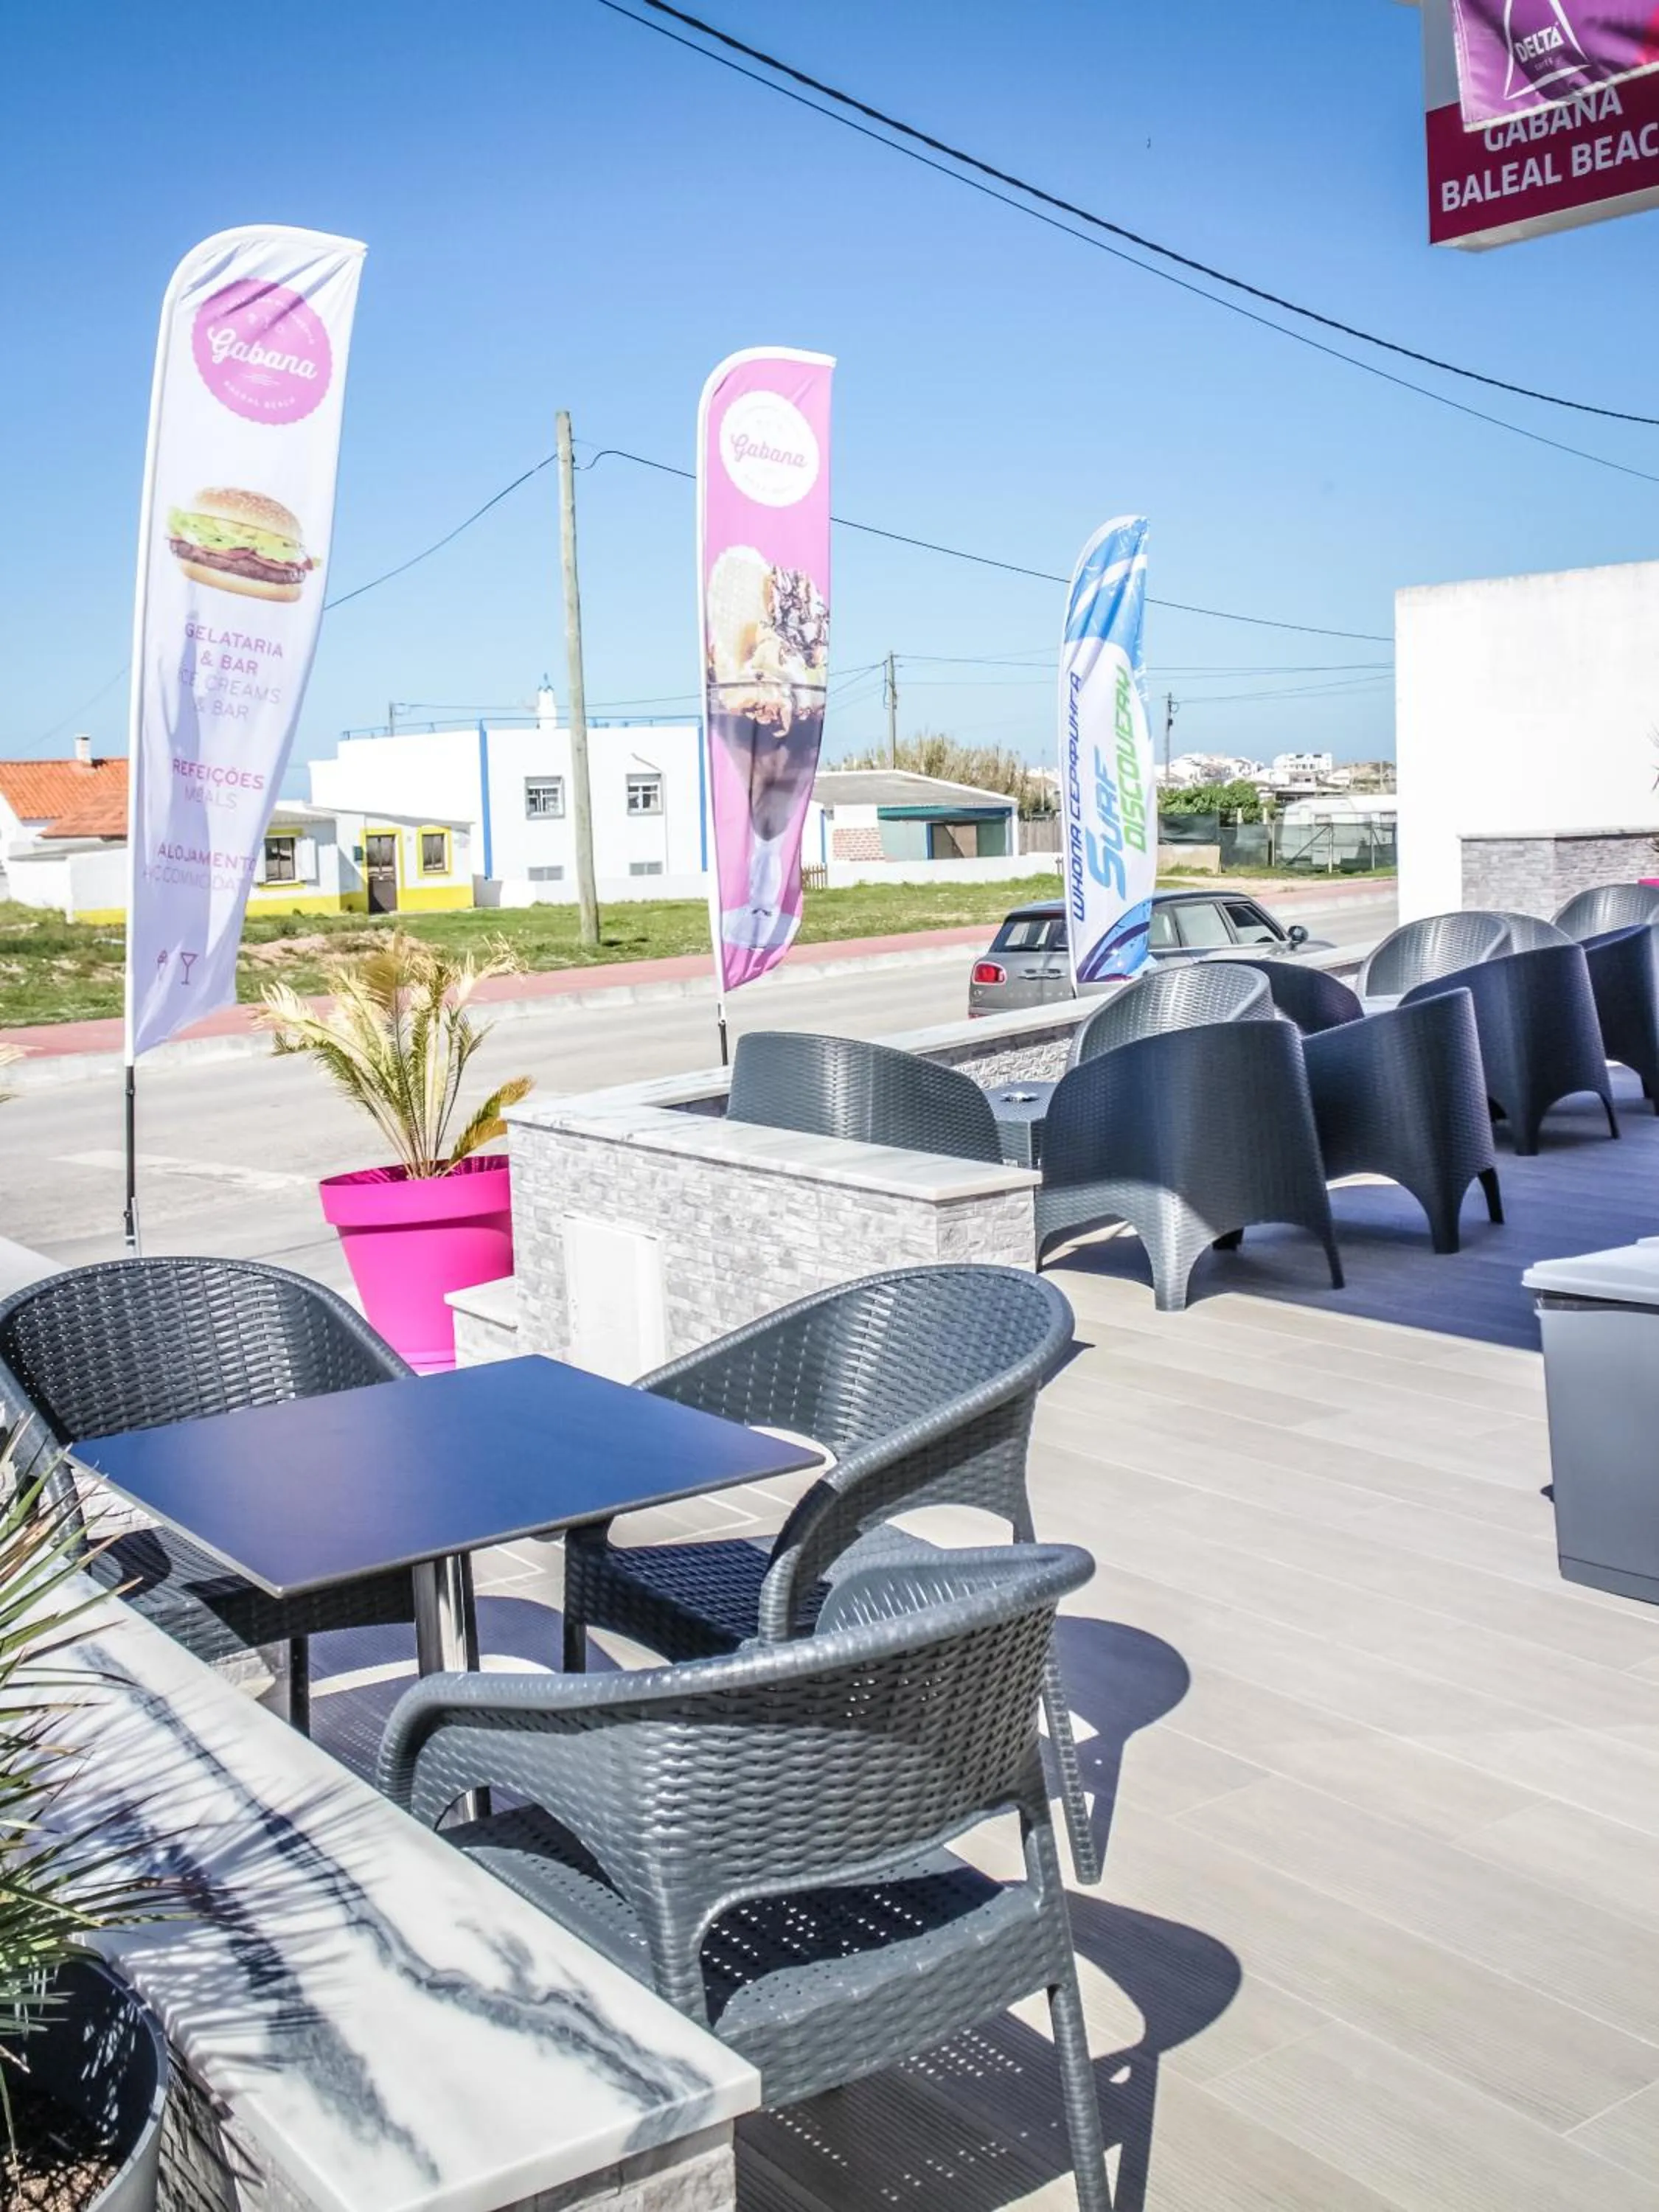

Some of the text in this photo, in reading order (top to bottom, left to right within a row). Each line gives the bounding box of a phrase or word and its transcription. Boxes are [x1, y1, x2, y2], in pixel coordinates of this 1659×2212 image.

[1514, 27, 1564, 63] DELTA
[1484, 85, 1623, 151] GABANA
[1441, 153, 1562, 212] BALEAL
[206, 327, 318, 380] Gabana
[730, 433, 807, 468] Gabana
[185, 622, 283, 658] GELATARIA
[200, 650, 258, 676] & BAR
[205, 674, 282, 704] CREAMS
[211, 699, 249, 720] BAR
[173, 758, 265, 790] REFEIÇÕES
[1116, 664, 1147, 854] DISCOVERY
